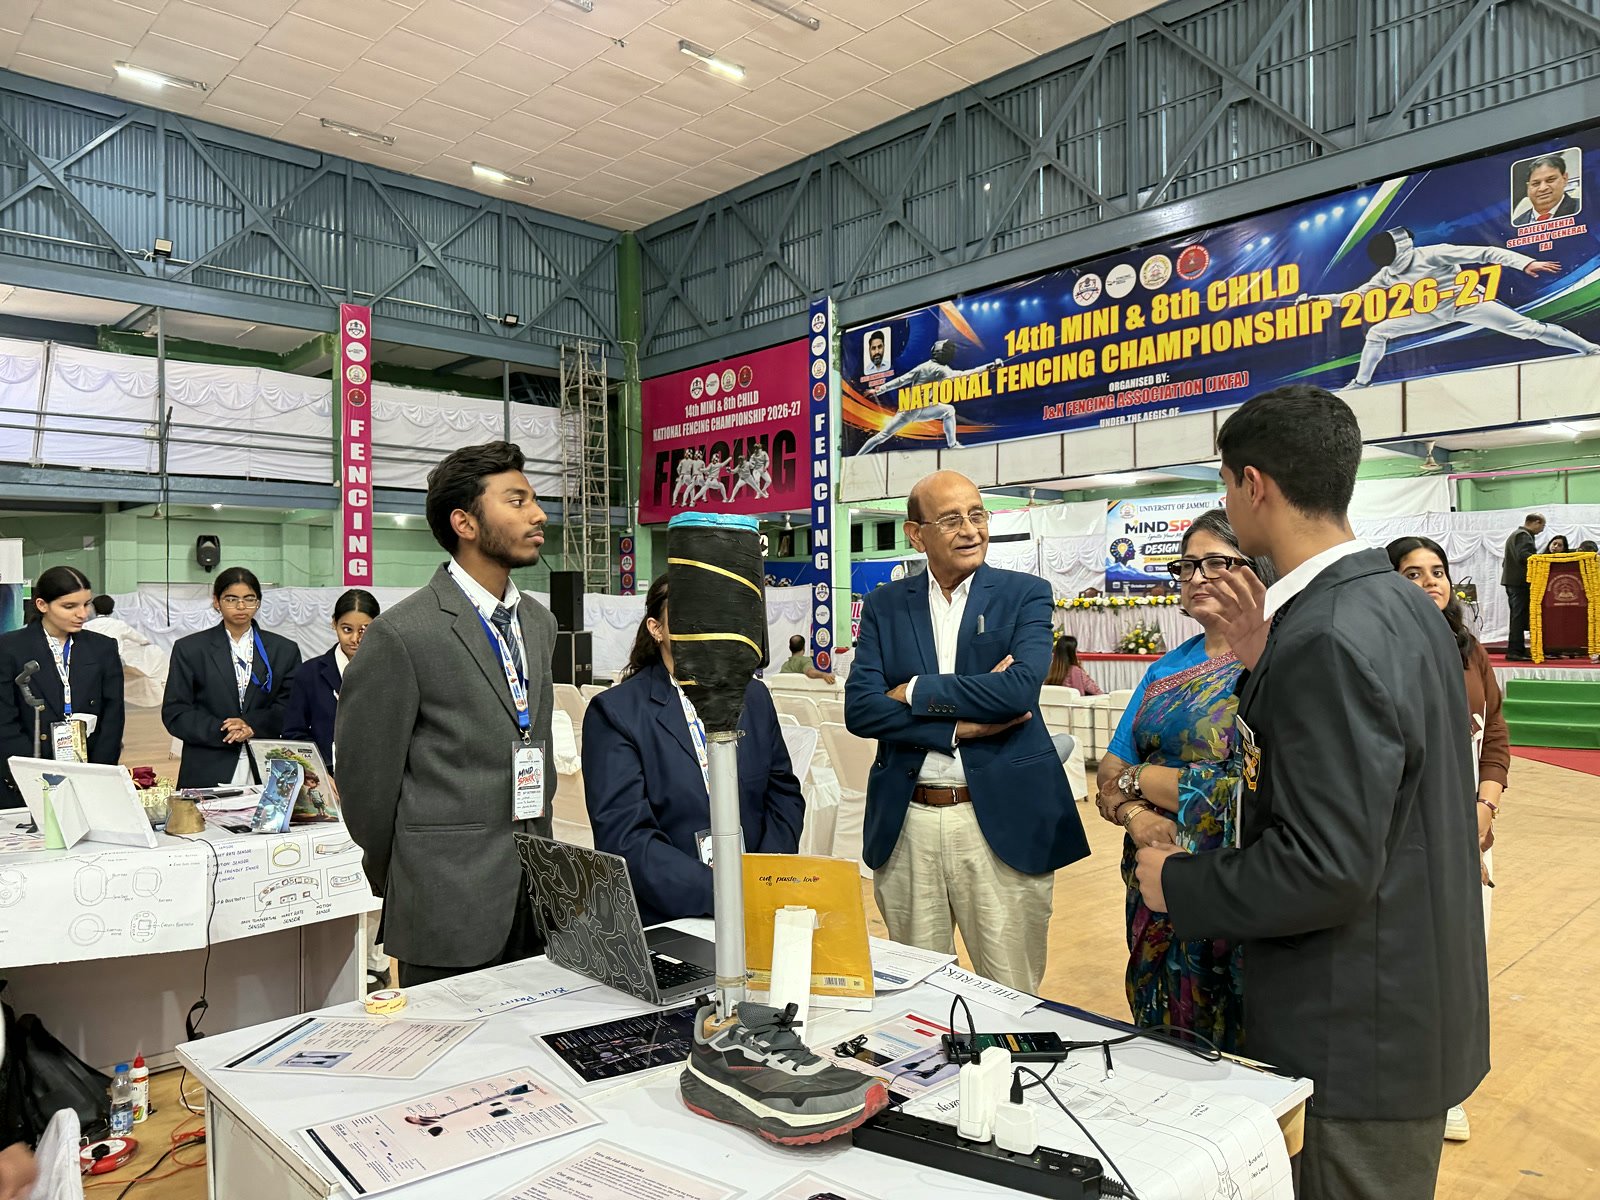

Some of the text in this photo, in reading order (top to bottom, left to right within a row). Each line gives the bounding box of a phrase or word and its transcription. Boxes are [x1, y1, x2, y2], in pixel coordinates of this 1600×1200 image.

[1507, 225, 1587, 248] SECRETARY GENERAL
[1518, 217, 1575, 236] RAJEEV MEHTA
[1539, 241, 1553, 252] FAI
[1005, 321, 1055, 357] 14th
[1060, 305, 1119, 347] MINI
[1125, 304, 1146, 330] &
[1152, 287, 1200, 324] 8th
[1206, 263, 1300, 312] CHILD
[898, 264, 1502, 413] NATIONAL FENCING CHAMPIONSHIP 2026-27
[1108, 373, 1170, 393] ORGANISED BY:
[685, 390, 759, 418] 14th MINI & 8th CHILD
[1043, 370, 1250, 421] J&K FENCING ASSOCIATION (JKFA)
[653, 400, 801, 441] NATIONAL FENCING CHAMPIONSHIP 2026-27
[1099, 407, 1180, 428] UNDER THE AEGIS OF
[347, 419, 368, 577] FENCING
[813, 413, 829, 571] FENCING
[1139, 502, 1210, 513] UNIVERSITY OF JAMMU
[1125, 520, 1193, 534] MINDSP
[1145, 543, 1179, 555] DESIGN
[518, 766, 534, 779] MIND
[759, 875, 772, 885] cut
[989, 986, 1021, 1001] THE
